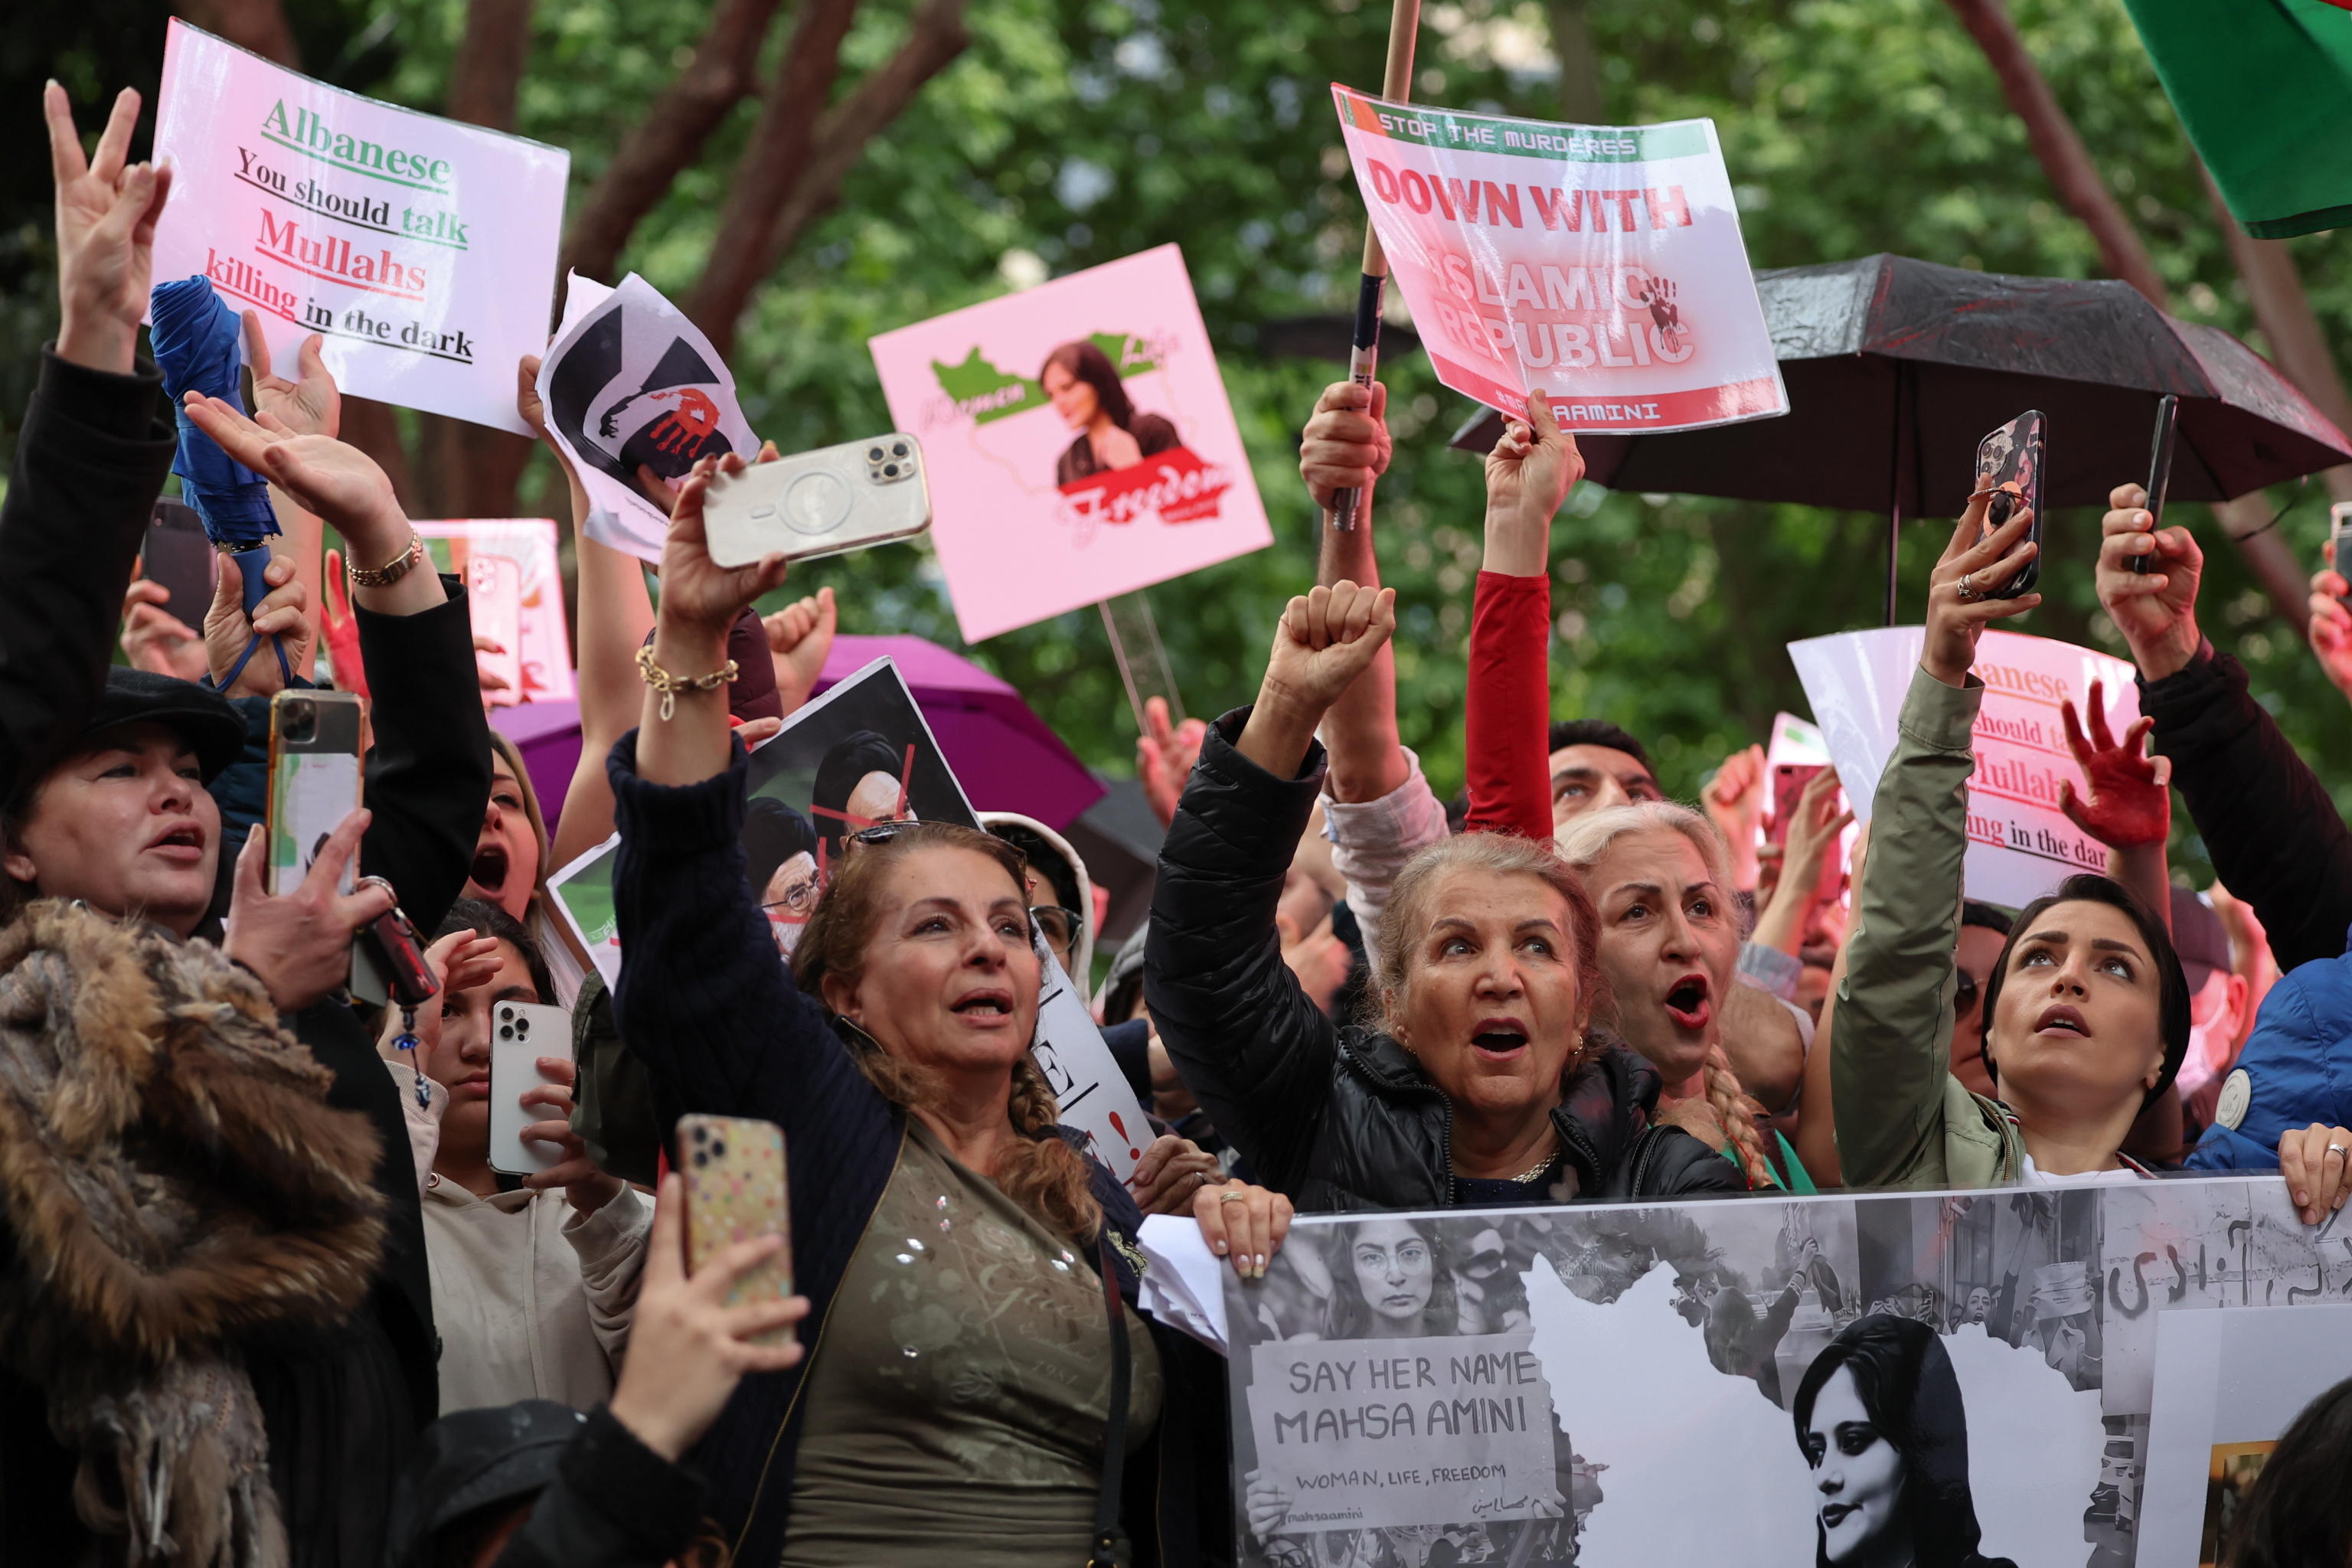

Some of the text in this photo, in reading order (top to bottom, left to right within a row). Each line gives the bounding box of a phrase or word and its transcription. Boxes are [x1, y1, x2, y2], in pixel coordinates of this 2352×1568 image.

[263, 98, 452, 185] Albanese
[1379, 112, 1636, 155] STOP THE MURDERES
[237, 146, 469, 244] You should talk
[1366, 158, 1694, 233] DOWN WITH
[256, 207, 426, 292] Mullahs
[1428, 250, 1655, 310] ISLAMIC
[204, 248, 474, 358] killing in the dark
[1433, 299, 1694, 368] REPUBLIC
[2011, 820, 2031, 848] in
[2037, 828, 2069, 858] the
[2075, 839, 2106, 867] dar
[1289, 1351, 1537, 1394] SAY HER NAME
[1274, 1396, 1527, 1445] MAHSA AMINI
[1432, 1463, 1504, 1485] FREEDOM
